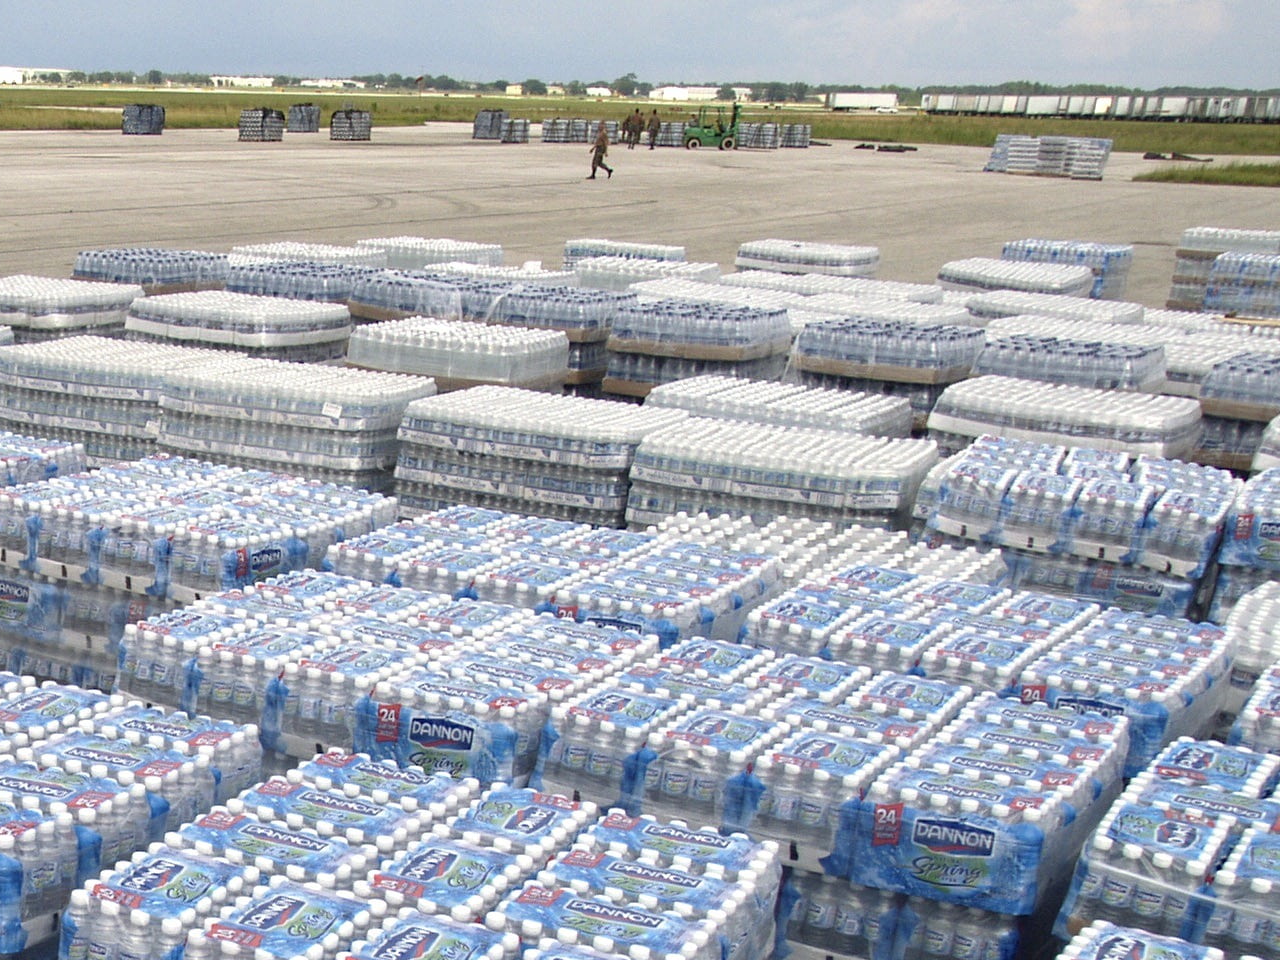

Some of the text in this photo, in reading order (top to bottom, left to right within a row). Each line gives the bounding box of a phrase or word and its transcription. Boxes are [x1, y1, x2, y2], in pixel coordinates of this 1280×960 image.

[1023, 687, 1042, 701] 24
[379, 705, 397, 723] 24
[410, 721, 473, 747] DANNON
[876, 808, 897, 825] 24
[244, 825, 329, 851] DANNON
[916, 822, 994, 850] DANNON
[609, 862, 700, 888] DANNON
[911, 855, 983, 884] Spring
[242, 895, 299, 930] DANNON
[566, 901, 662, 928] DANNON
